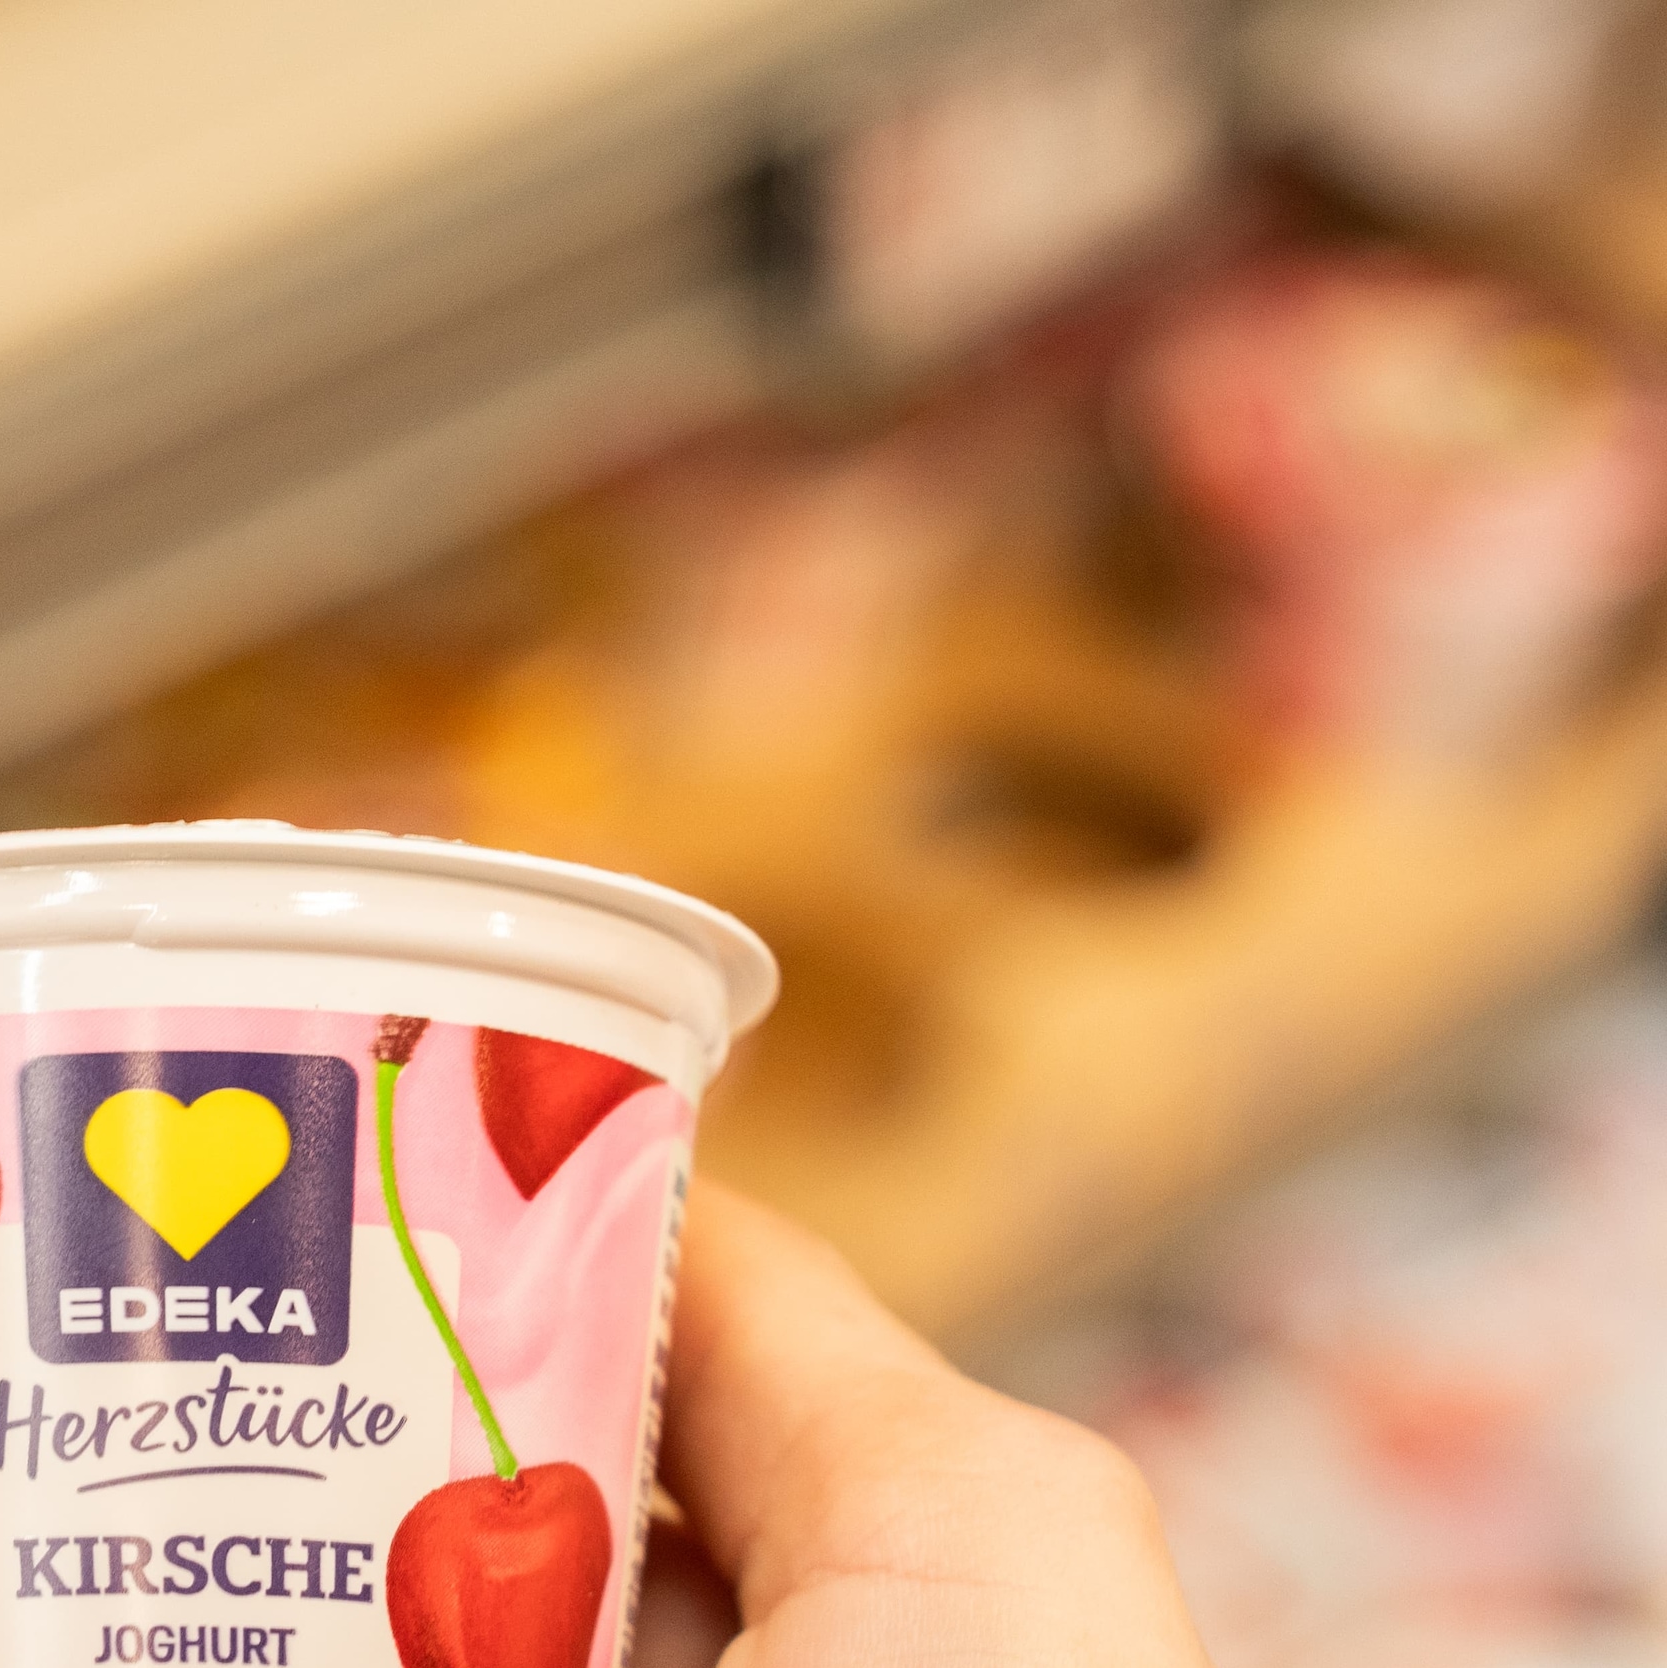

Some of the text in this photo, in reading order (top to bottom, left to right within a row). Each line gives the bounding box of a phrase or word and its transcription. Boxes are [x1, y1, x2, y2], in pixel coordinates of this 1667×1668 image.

[59, 1286, 317, 1335] EDEKA
[13, 1535, 374, 1604] KIRSCHE
[94, 1625, 296, 1667] JOGHURT
